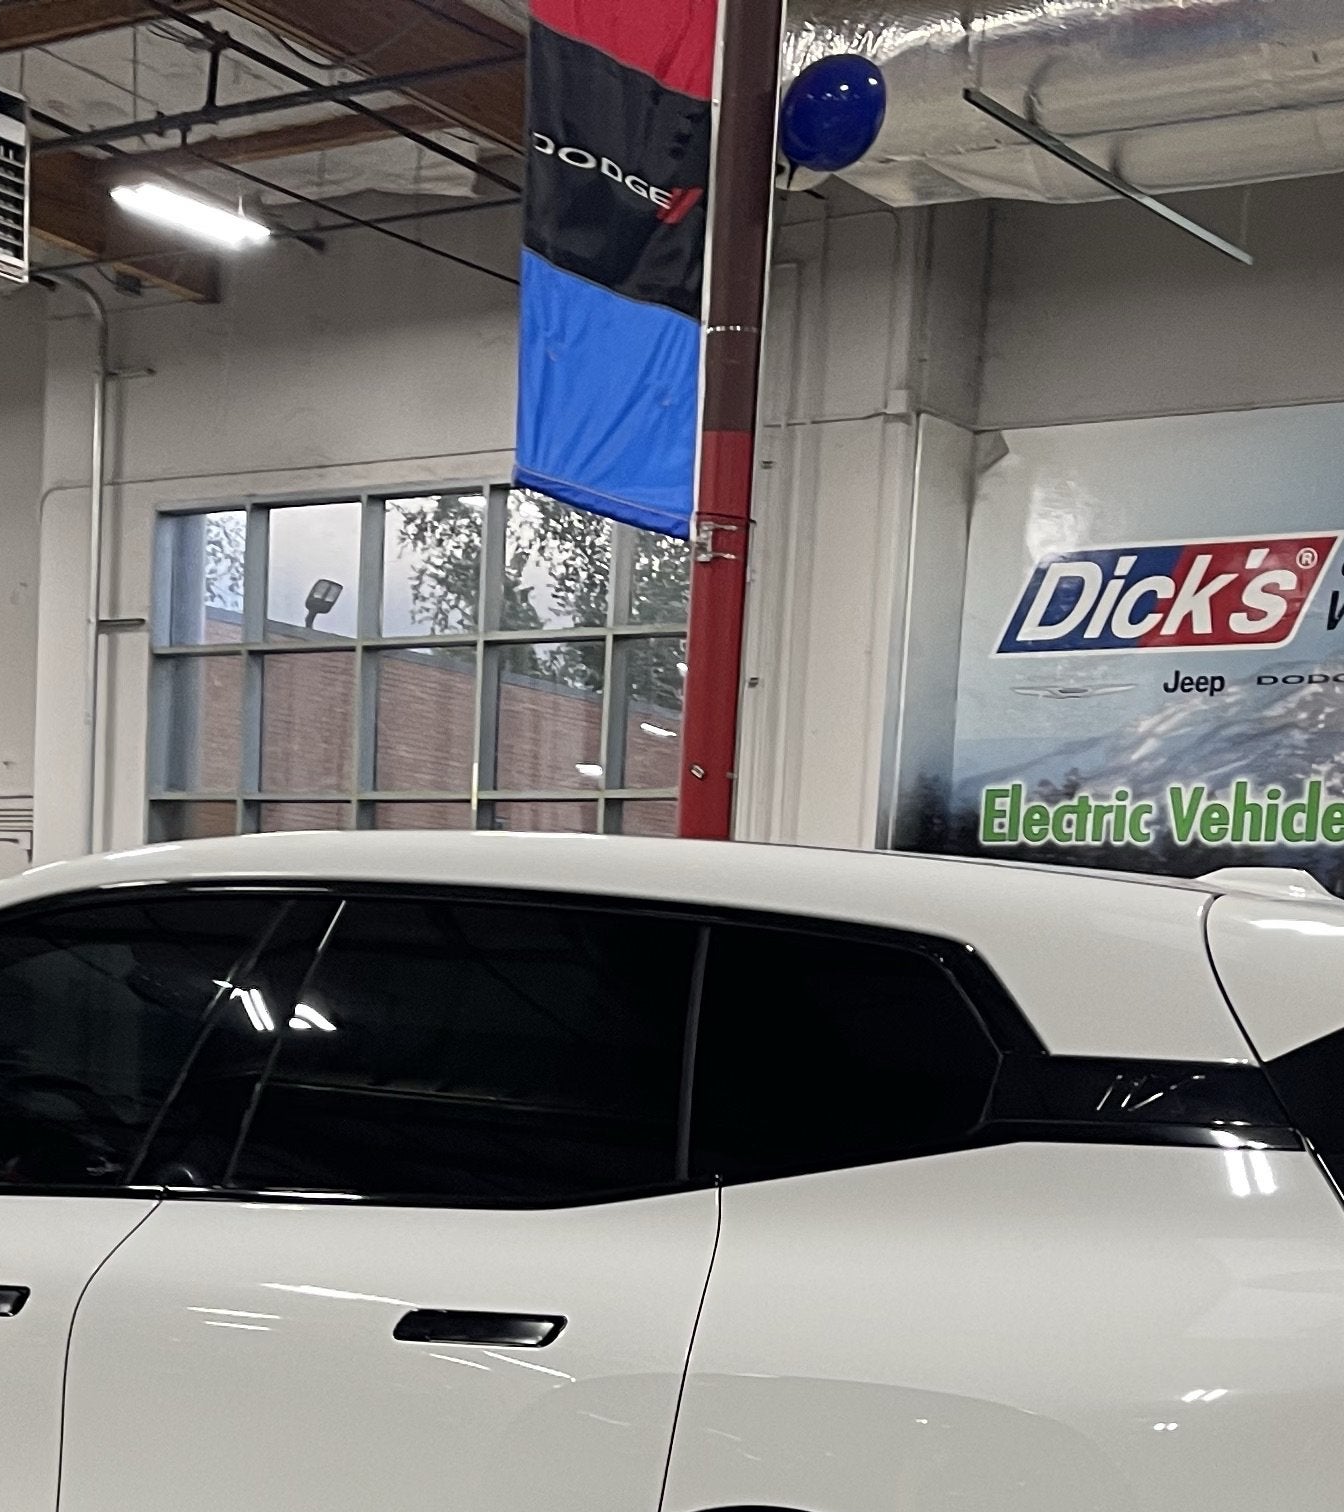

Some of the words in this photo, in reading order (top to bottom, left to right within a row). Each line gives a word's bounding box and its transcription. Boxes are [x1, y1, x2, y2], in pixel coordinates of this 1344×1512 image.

[531, 132, 672, 210] DODGE
[1015, 548, 1298, 641] Dick's
[1163, 670, 1225, 697] Jeep
[982, 783, 1152, 843] Electric
